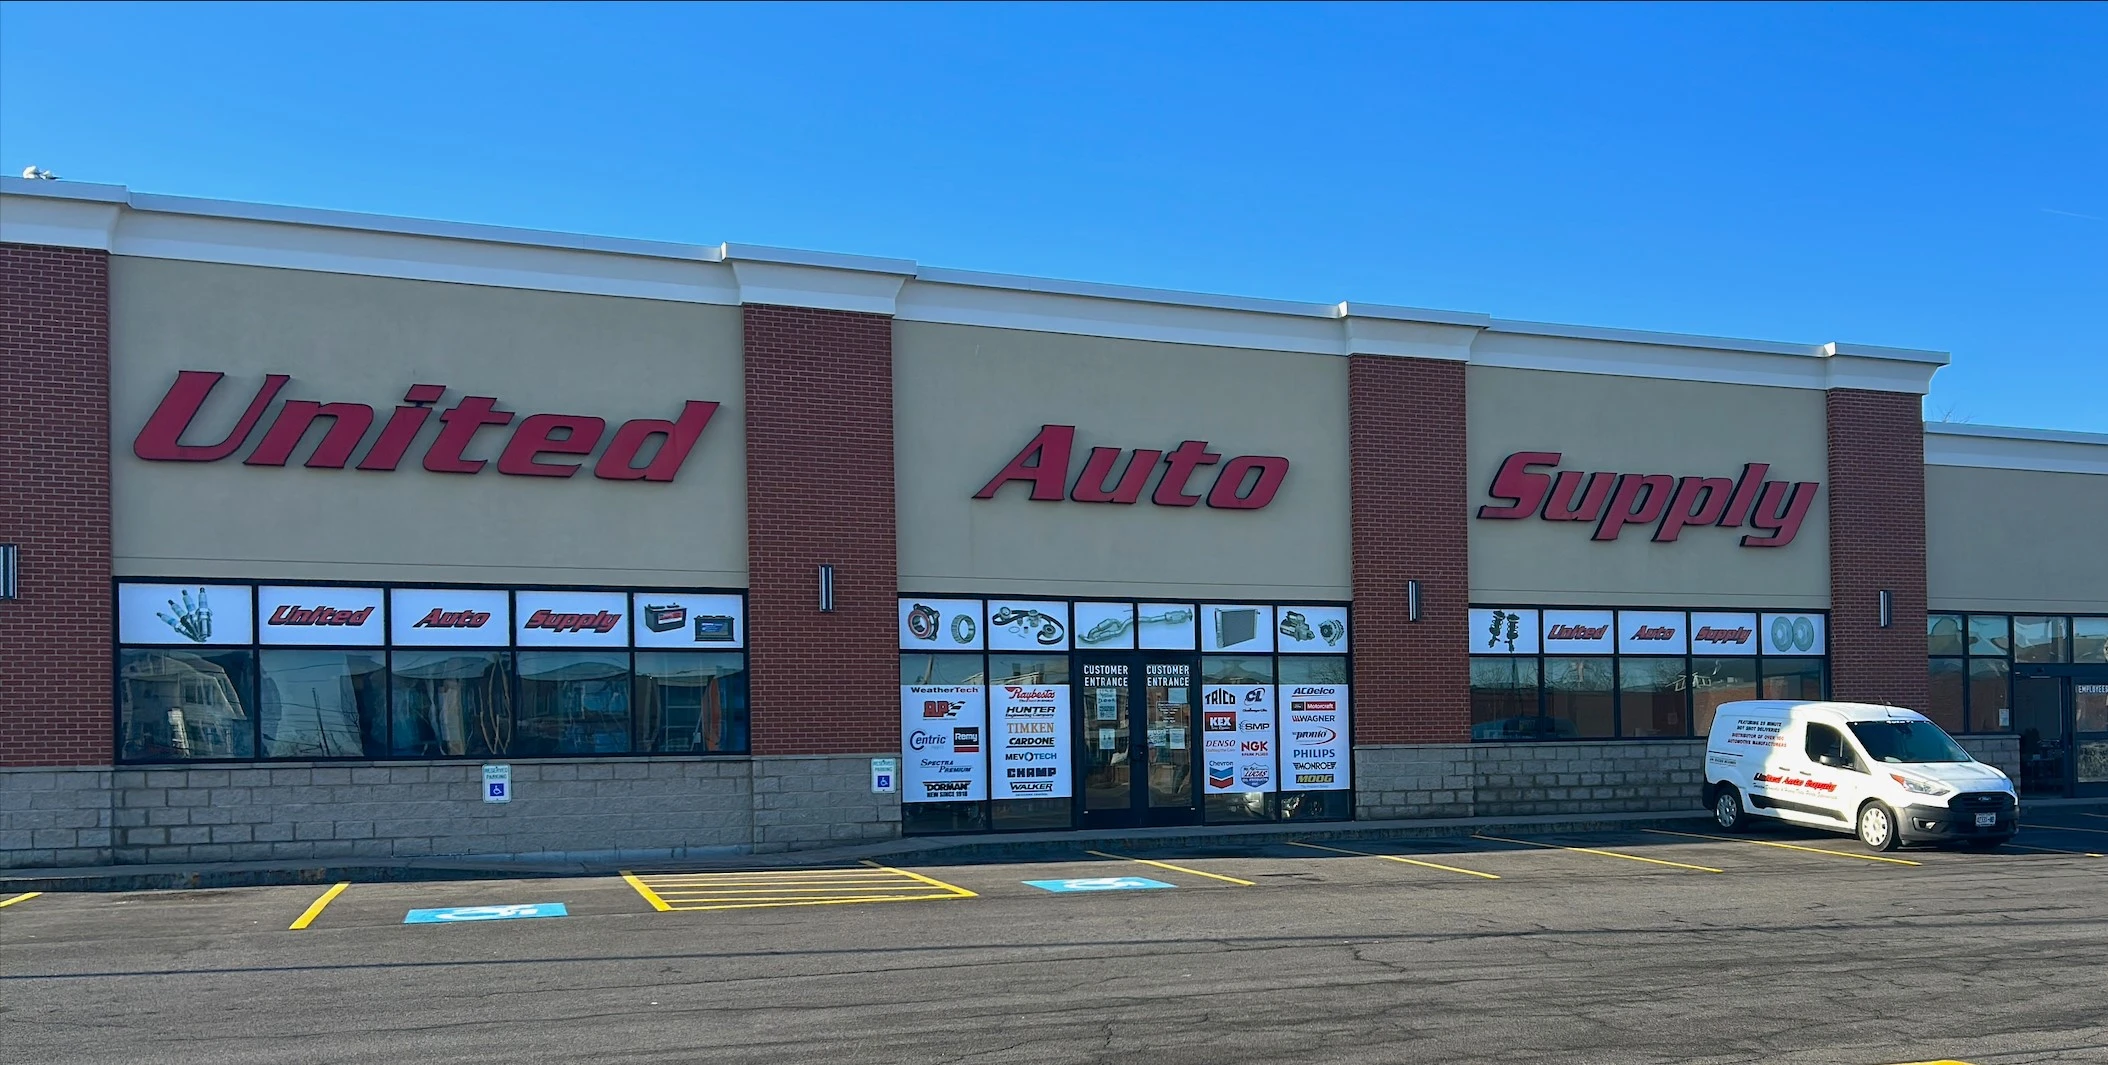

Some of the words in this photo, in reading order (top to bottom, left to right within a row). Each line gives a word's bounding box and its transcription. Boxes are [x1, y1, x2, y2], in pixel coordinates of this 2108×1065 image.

[133, 370, 721, 482] United
[971, 424, 1290, 510] Auto
[1476, 451, 1820, 548] Supply
[267, 604, 375, 627] United
[412, 608, 491, 628] Auto
[523, 609, 623, 634] Supply
[1547, 624, 1610, 641] United
[1630, 625, 1676, 641] Auto
[1695, 626, 1753, 645] Supply
[1083, 665, 1129, 675] CUSTOMER
[1146, 665, 1190, 675] CUSTOMER
[1084, 676, 1129, 687] ENTRANCE
[1146, 676, 1190, 687] ENTRANCE
[910, 686, 979, 694] WeatherTech
[1004, 686, 1056, 700] Raybestos
[1292, 687, 1335, 695] ACDelco
[1204, 687, 1236, 705] TRICO
[1006, 706, 1056, 714] HUNTER
[1307, 702, 1335, 710] Motorcraft
[1209, 716, 1232, 727] KEX
[1006, 723, 1055, 734] TIMKEN
[954, 733, 978, 742] Remy
[1296, 730, 1328, 740] pronto
[909, 730, 947, 751] Centric
[1009, 737, 1056, 745] CARDONE
[1241, 741, 1269, 752] NGK
[1005, 751, 1057, 762] MEVOTECH
[1293, 749, 1336, 758] PHILIPS
[1299, 761, 1331, 770] MONROE
[1007, 767, 1056, 778] CHAMP
[1297, 774, 1333, 783] MOOG
[1753, 772, 1783, 783] United
[1781, 777, 1804, 787] Auto
[1804, 779, 1838, 793] Supply
[926, 783, 969, 791] DORMAN
[1010, 782, 1053, 792] WALKER
